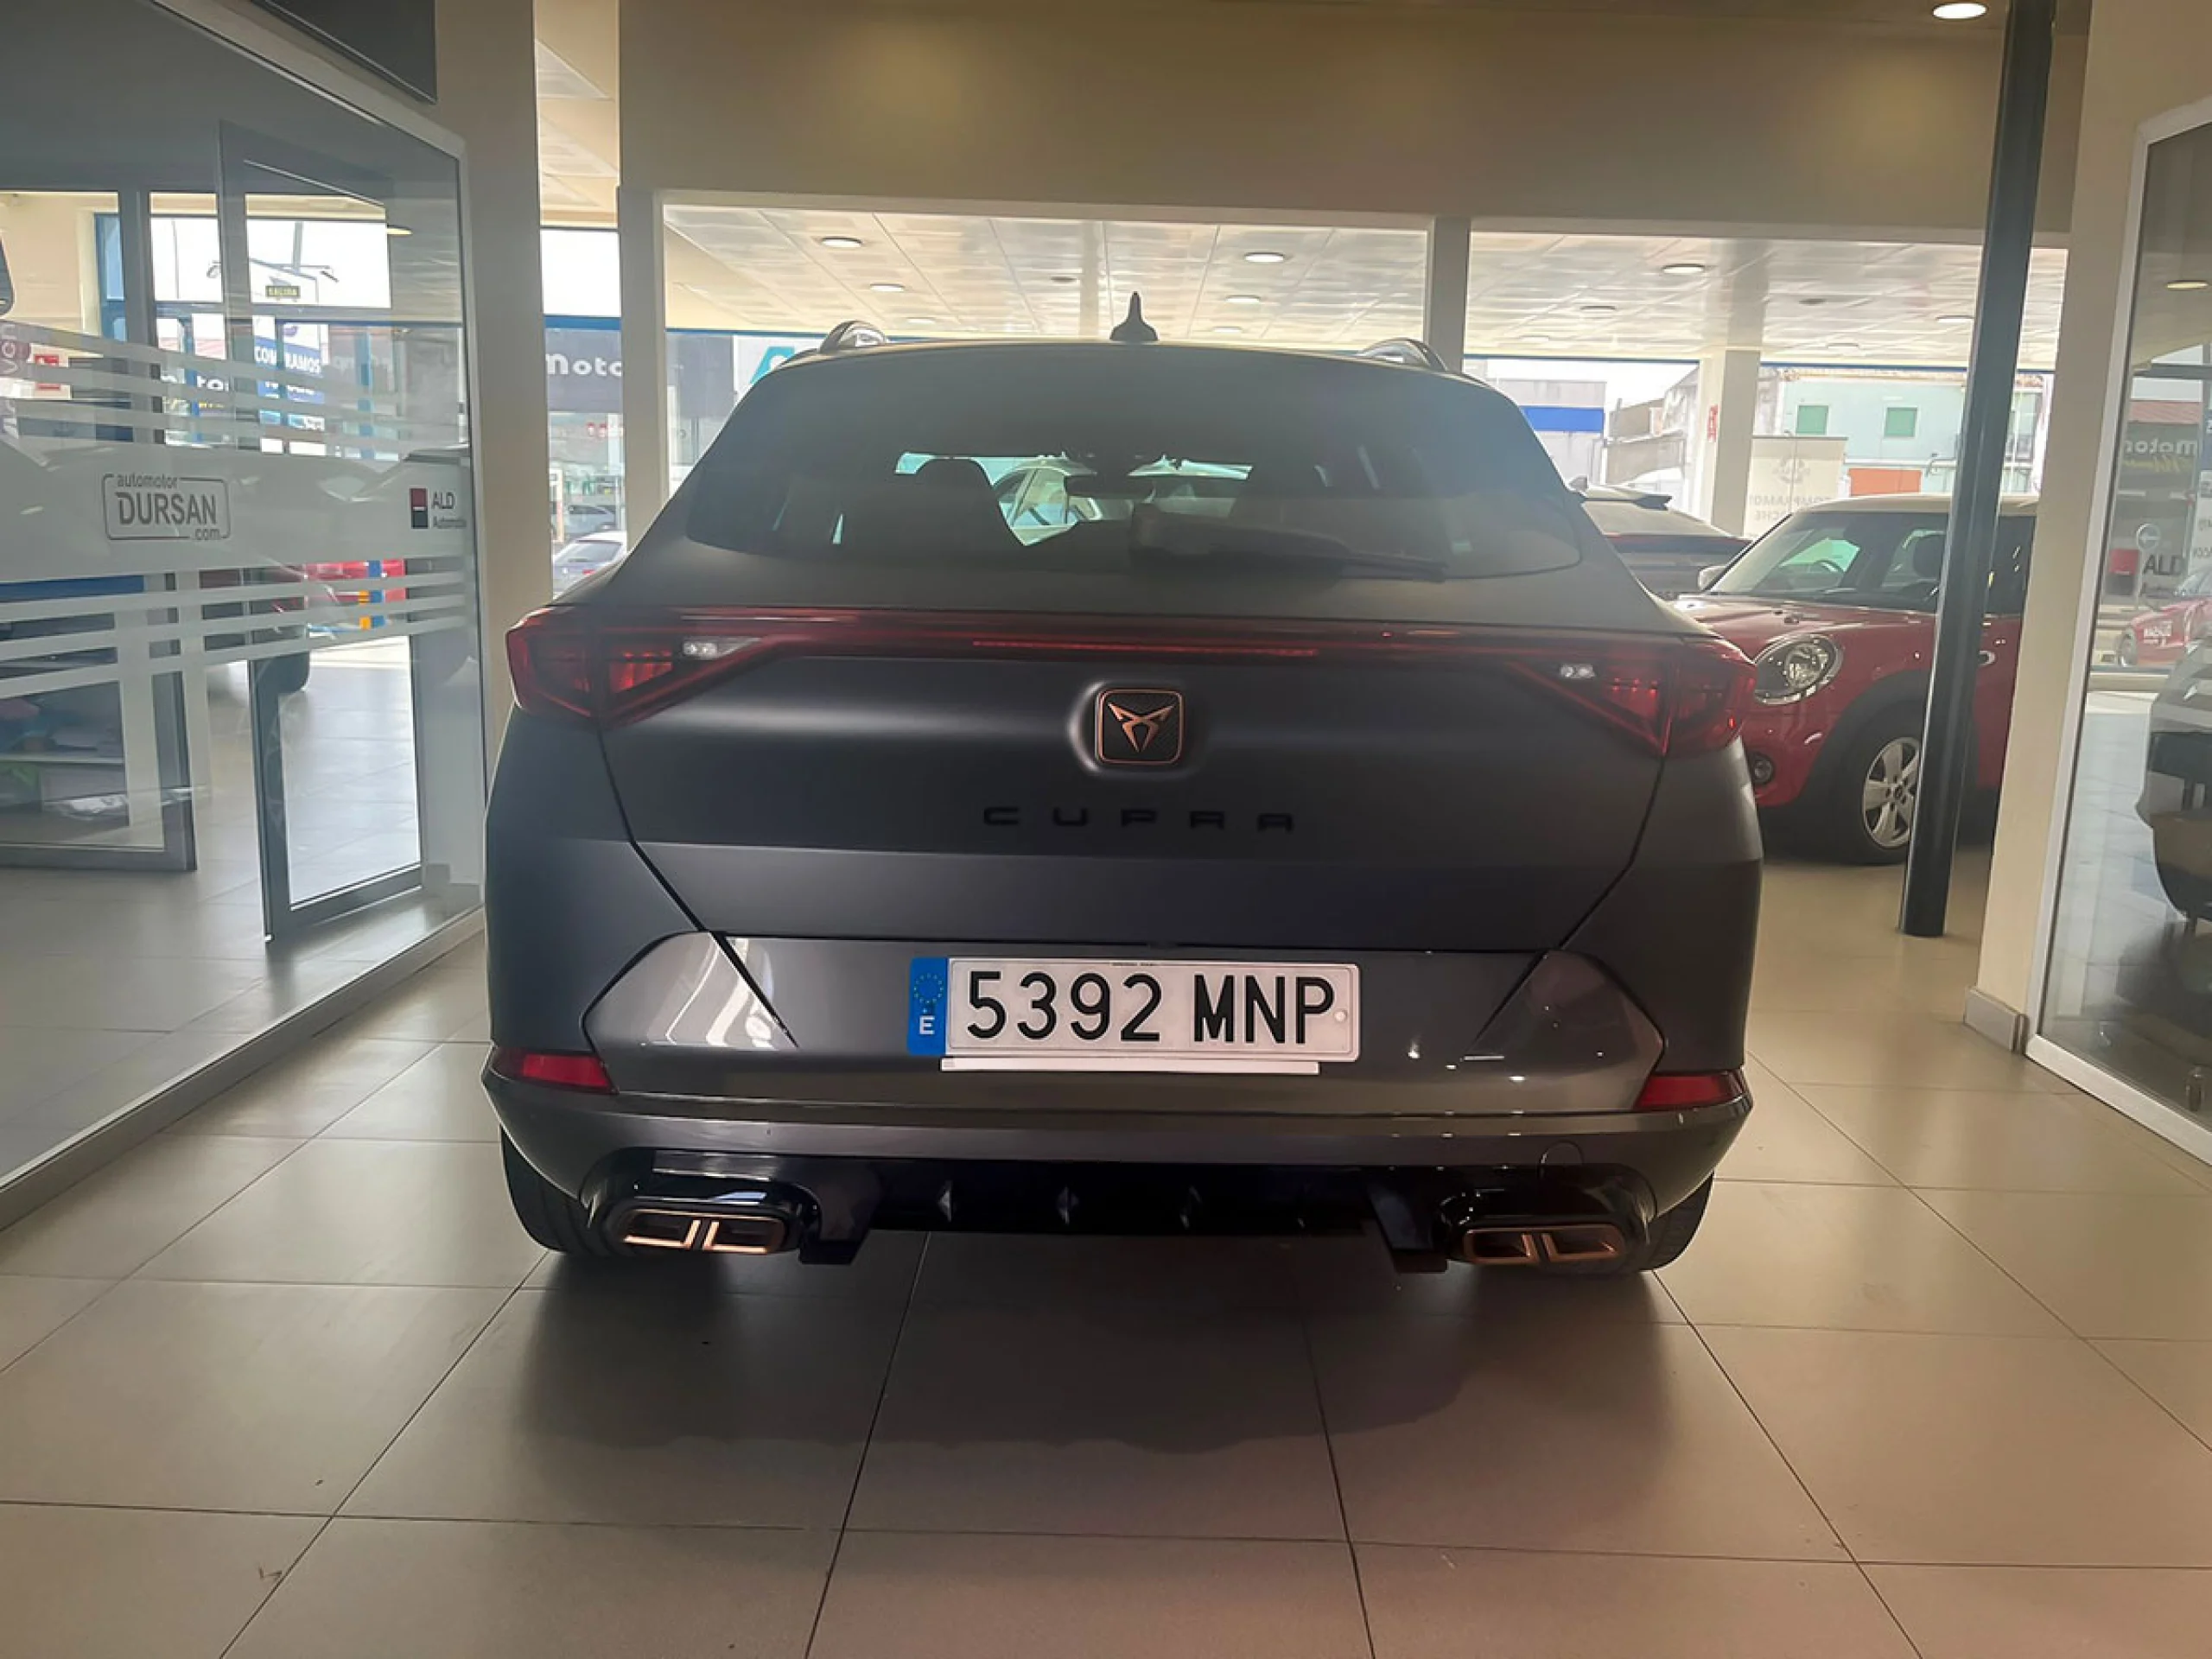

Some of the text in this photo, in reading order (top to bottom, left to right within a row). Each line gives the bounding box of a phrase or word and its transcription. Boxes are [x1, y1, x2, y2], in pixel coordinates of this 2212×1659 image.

[117, 474, 178, 489] automotor
[114, 492, 217, 525] DURSAN
[432, 491, 456, 510] ALD
[2141, 554, 2183, 575] ALD
[983, 806, 1293, 832] CUPRA
[919, 970, 1335, 1045] E 5392 MNP
